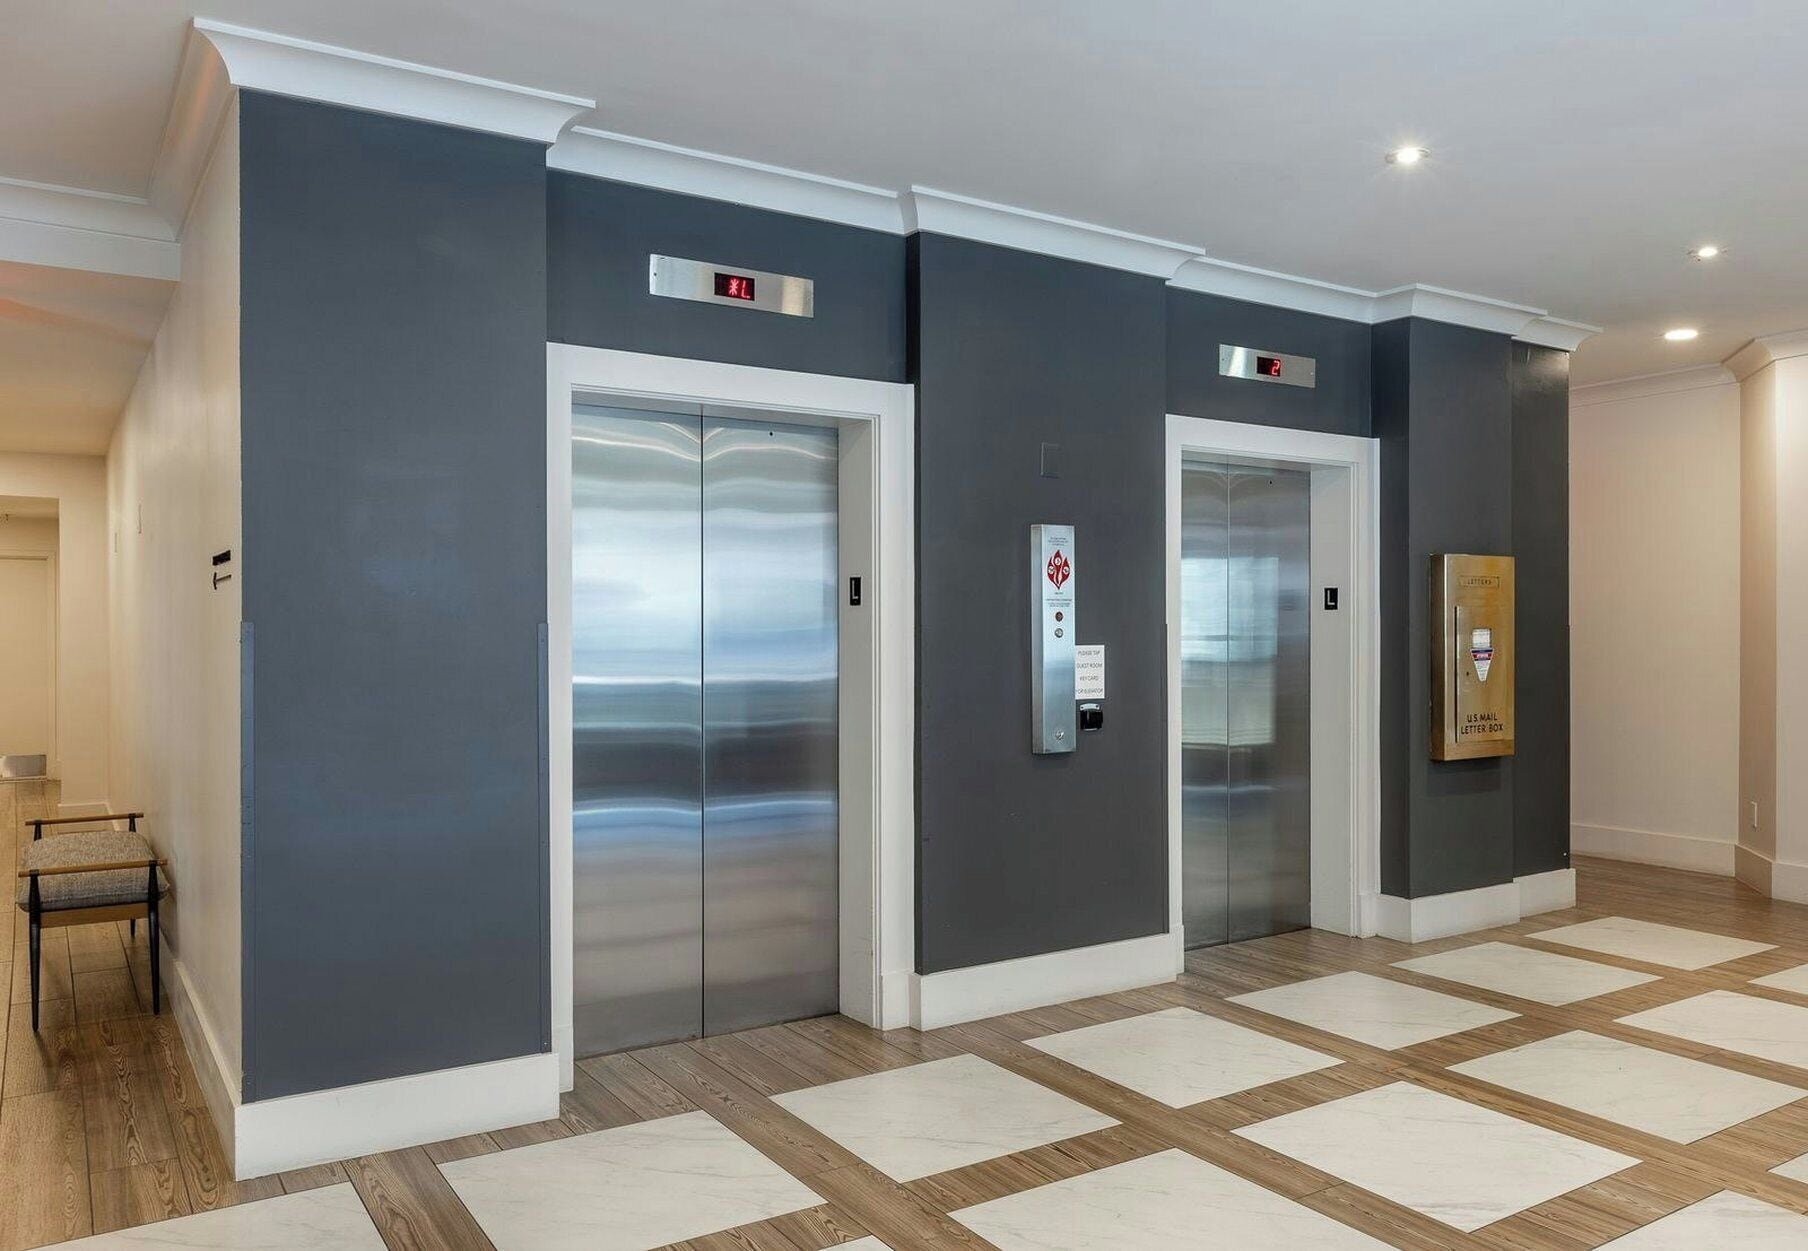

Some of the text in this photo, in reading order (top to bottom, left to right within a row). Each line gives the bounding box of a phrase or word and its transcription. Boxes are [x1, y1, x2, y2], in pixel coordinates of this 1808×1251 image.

[1271, 360, 1280, 375] 2
[852, 580, 859, 600] L
[1327, 590, 1335, 605] L
[1480, 712, 1498, 721] MAIL
[1461, 723, 1504, 735] LETTER BOX
